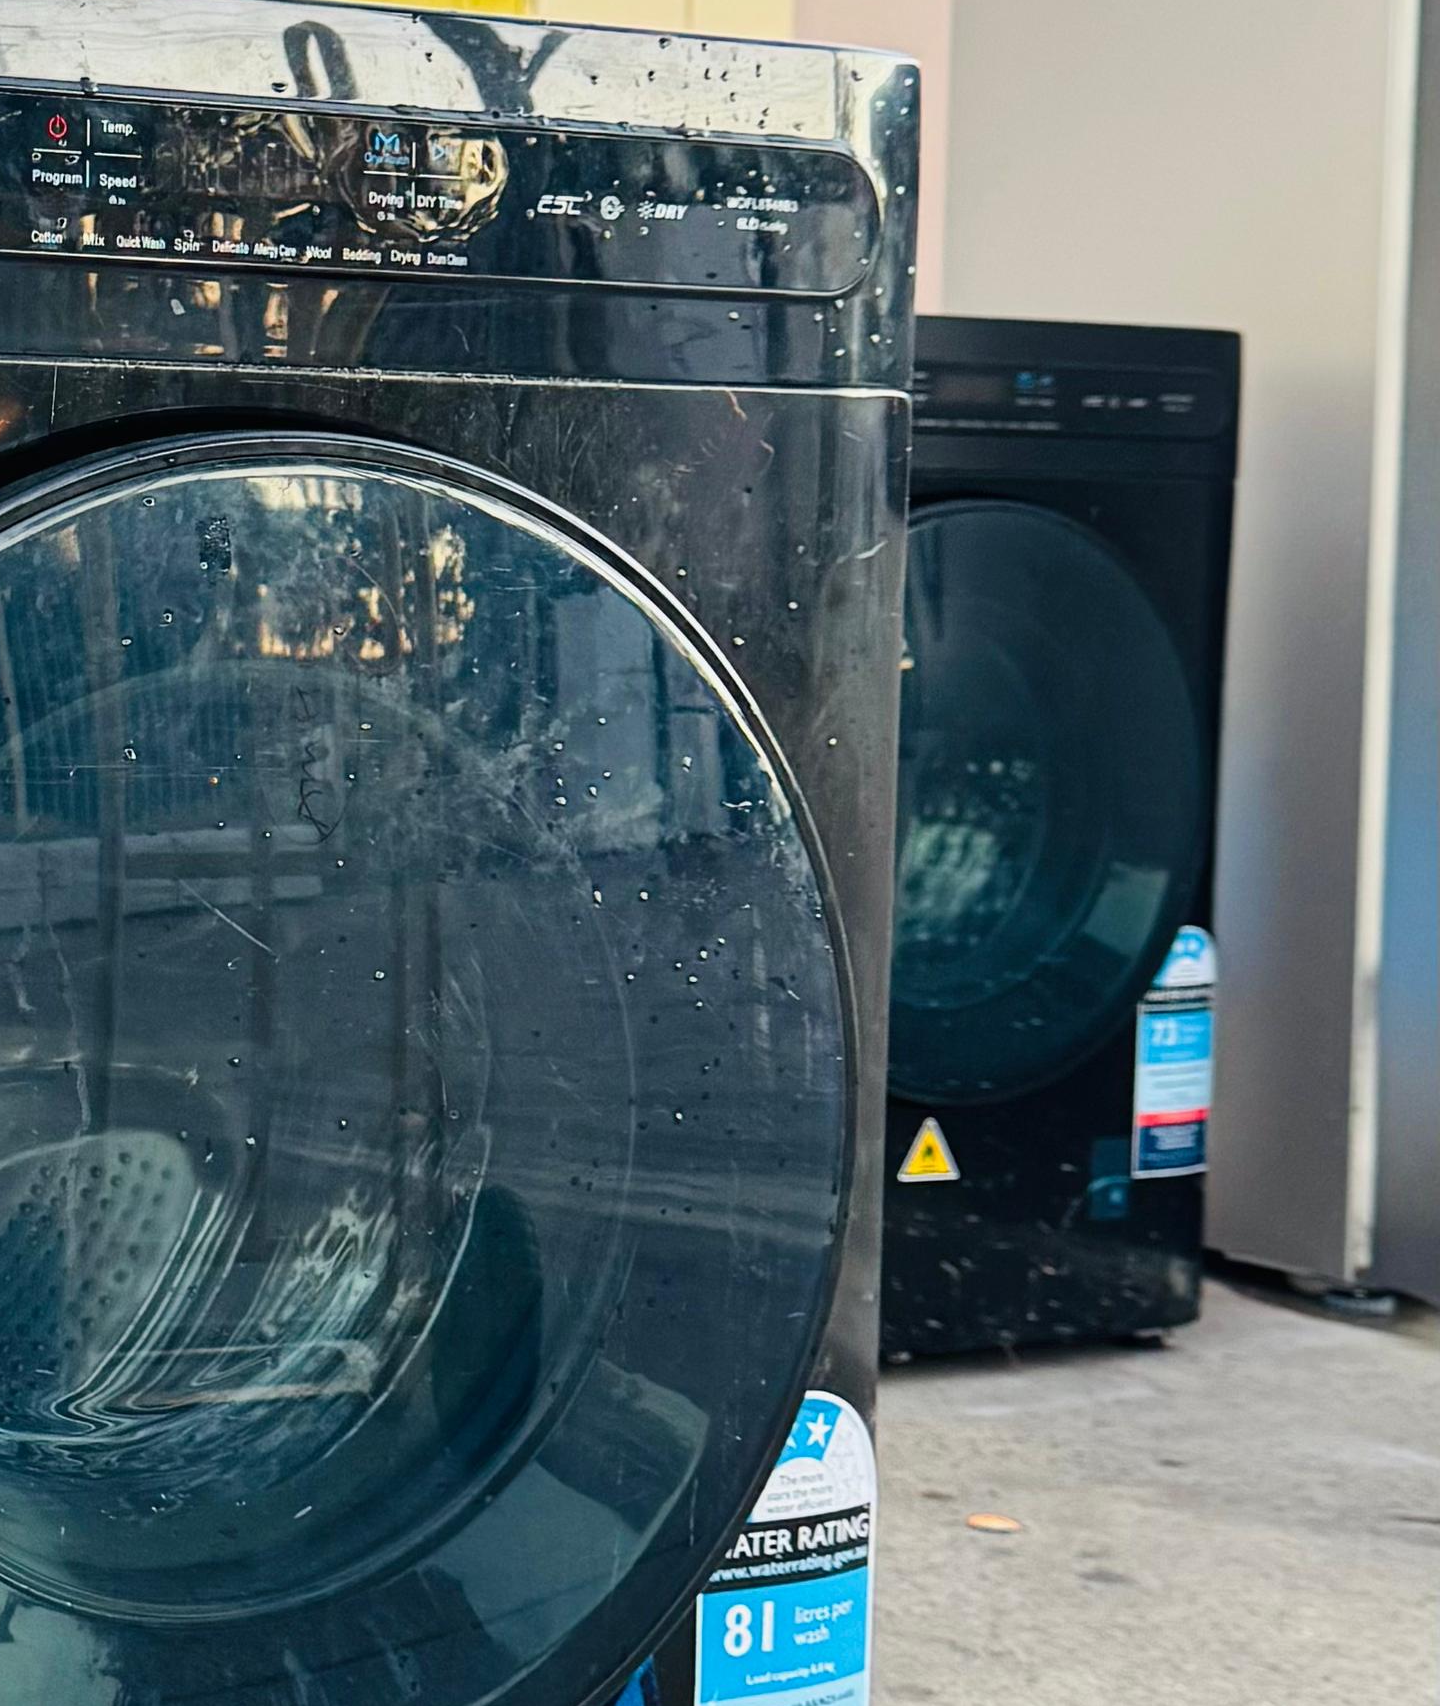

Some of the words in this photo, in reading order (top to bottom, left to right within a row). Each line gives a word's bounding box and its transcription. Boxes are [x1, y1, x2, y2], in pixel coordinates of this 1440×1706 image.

[101, 120, 137, 136] Temp.
[32, 169, 83, 186] Program
[99, 173, 137, 189] Speed
[369, 191, 404, 208] Drying
[416, 195, 435, 208] DIY
[654, 204, 688, 220] DRY
[31, 230, 63, 244] Cotton
[82, 232, 105, 246] Mix
[116, 235, 140, 248] Quick
[142, 236, 166, 250] Wash
[173, 237, 200, 253] Spin
[212, 240, 250, 255] Delicate
[306, 245, 332, 259] Wool
[342, 247, 382, 265] Bedding
[390, 249, 421, 266] Drying
[797, 1512, 870, 1551] RATING
[831, 1599, 854, 1622] per
[793, 1623, 830, 1645] wash
